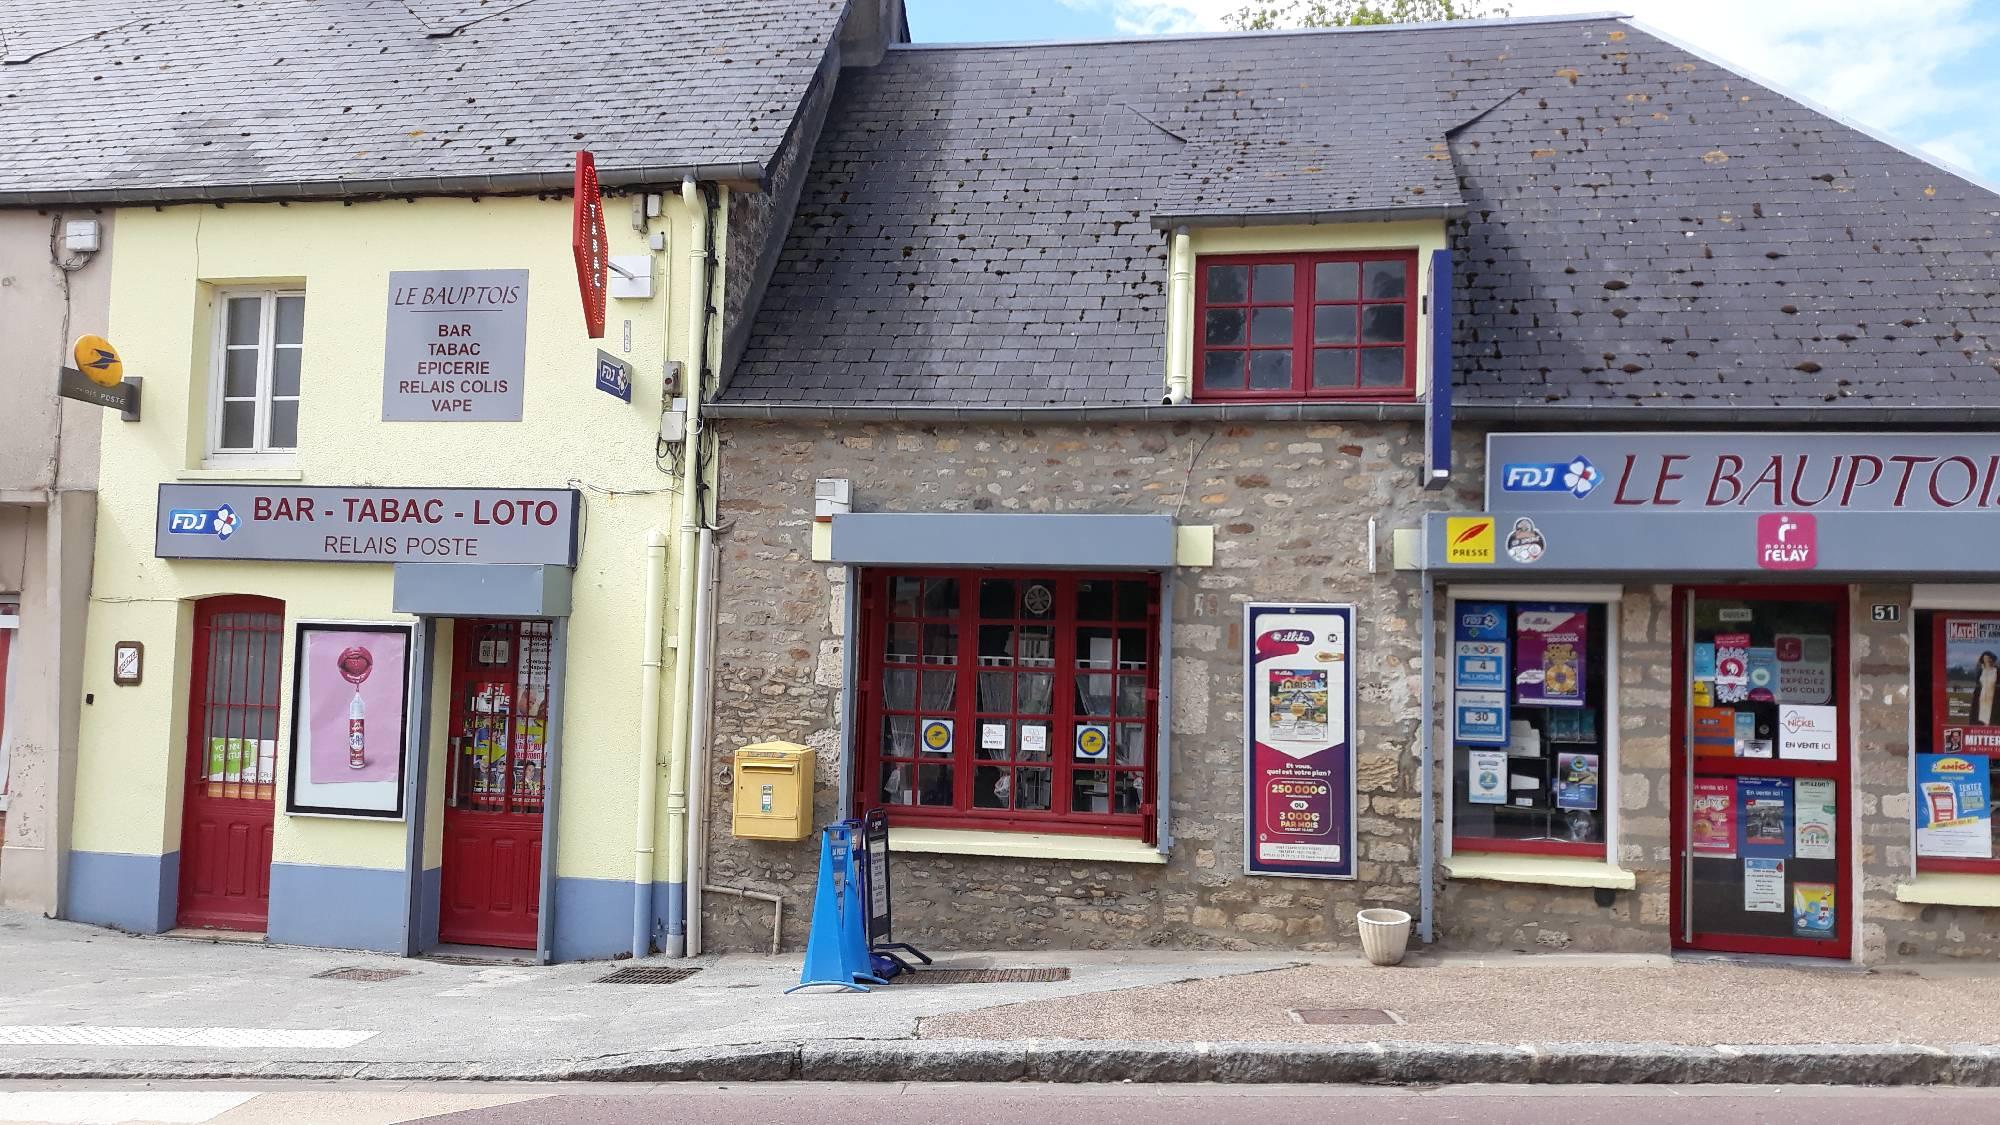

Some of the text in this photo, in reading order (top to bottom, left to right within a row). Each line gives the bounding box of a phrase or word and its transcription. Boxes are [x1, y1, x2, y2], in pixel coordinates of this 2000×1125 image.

[395, 286, 520, 306] LE BAUPTOIS
[438, 324, 472, 337] BAR
[428, 343, 481, 356] TABAC
[417, 361, 490, 375] EPICERIE
[602, 364, 615, 382] FDJ
[399, 379, 508, 393] RELAIS COLIS
[101, 393, 126, 405] POSTE
[431, 399, 472, 412] VAPE
[1506, 453, 2000, 508] FDJ LE BAUPTOI
[254, 496, 315, 522] BAR
[343, 498, 444, 524] TABAC
[473, 499, 558, 526] LOTO
[172, 512, 207, 530] FDJ
[324, 535, 478, 556] RELAIS POSTE
[1453, 548, 1489, 557] PRESSE
[1874, 605, 1895, 620] 51
[1475, 712, 1489, 721] 30
[1821, 742, 1831, 750] ICI
[1272, 784, 1292, 794] 250
[1298, 821, 1319, 829] MOIS
